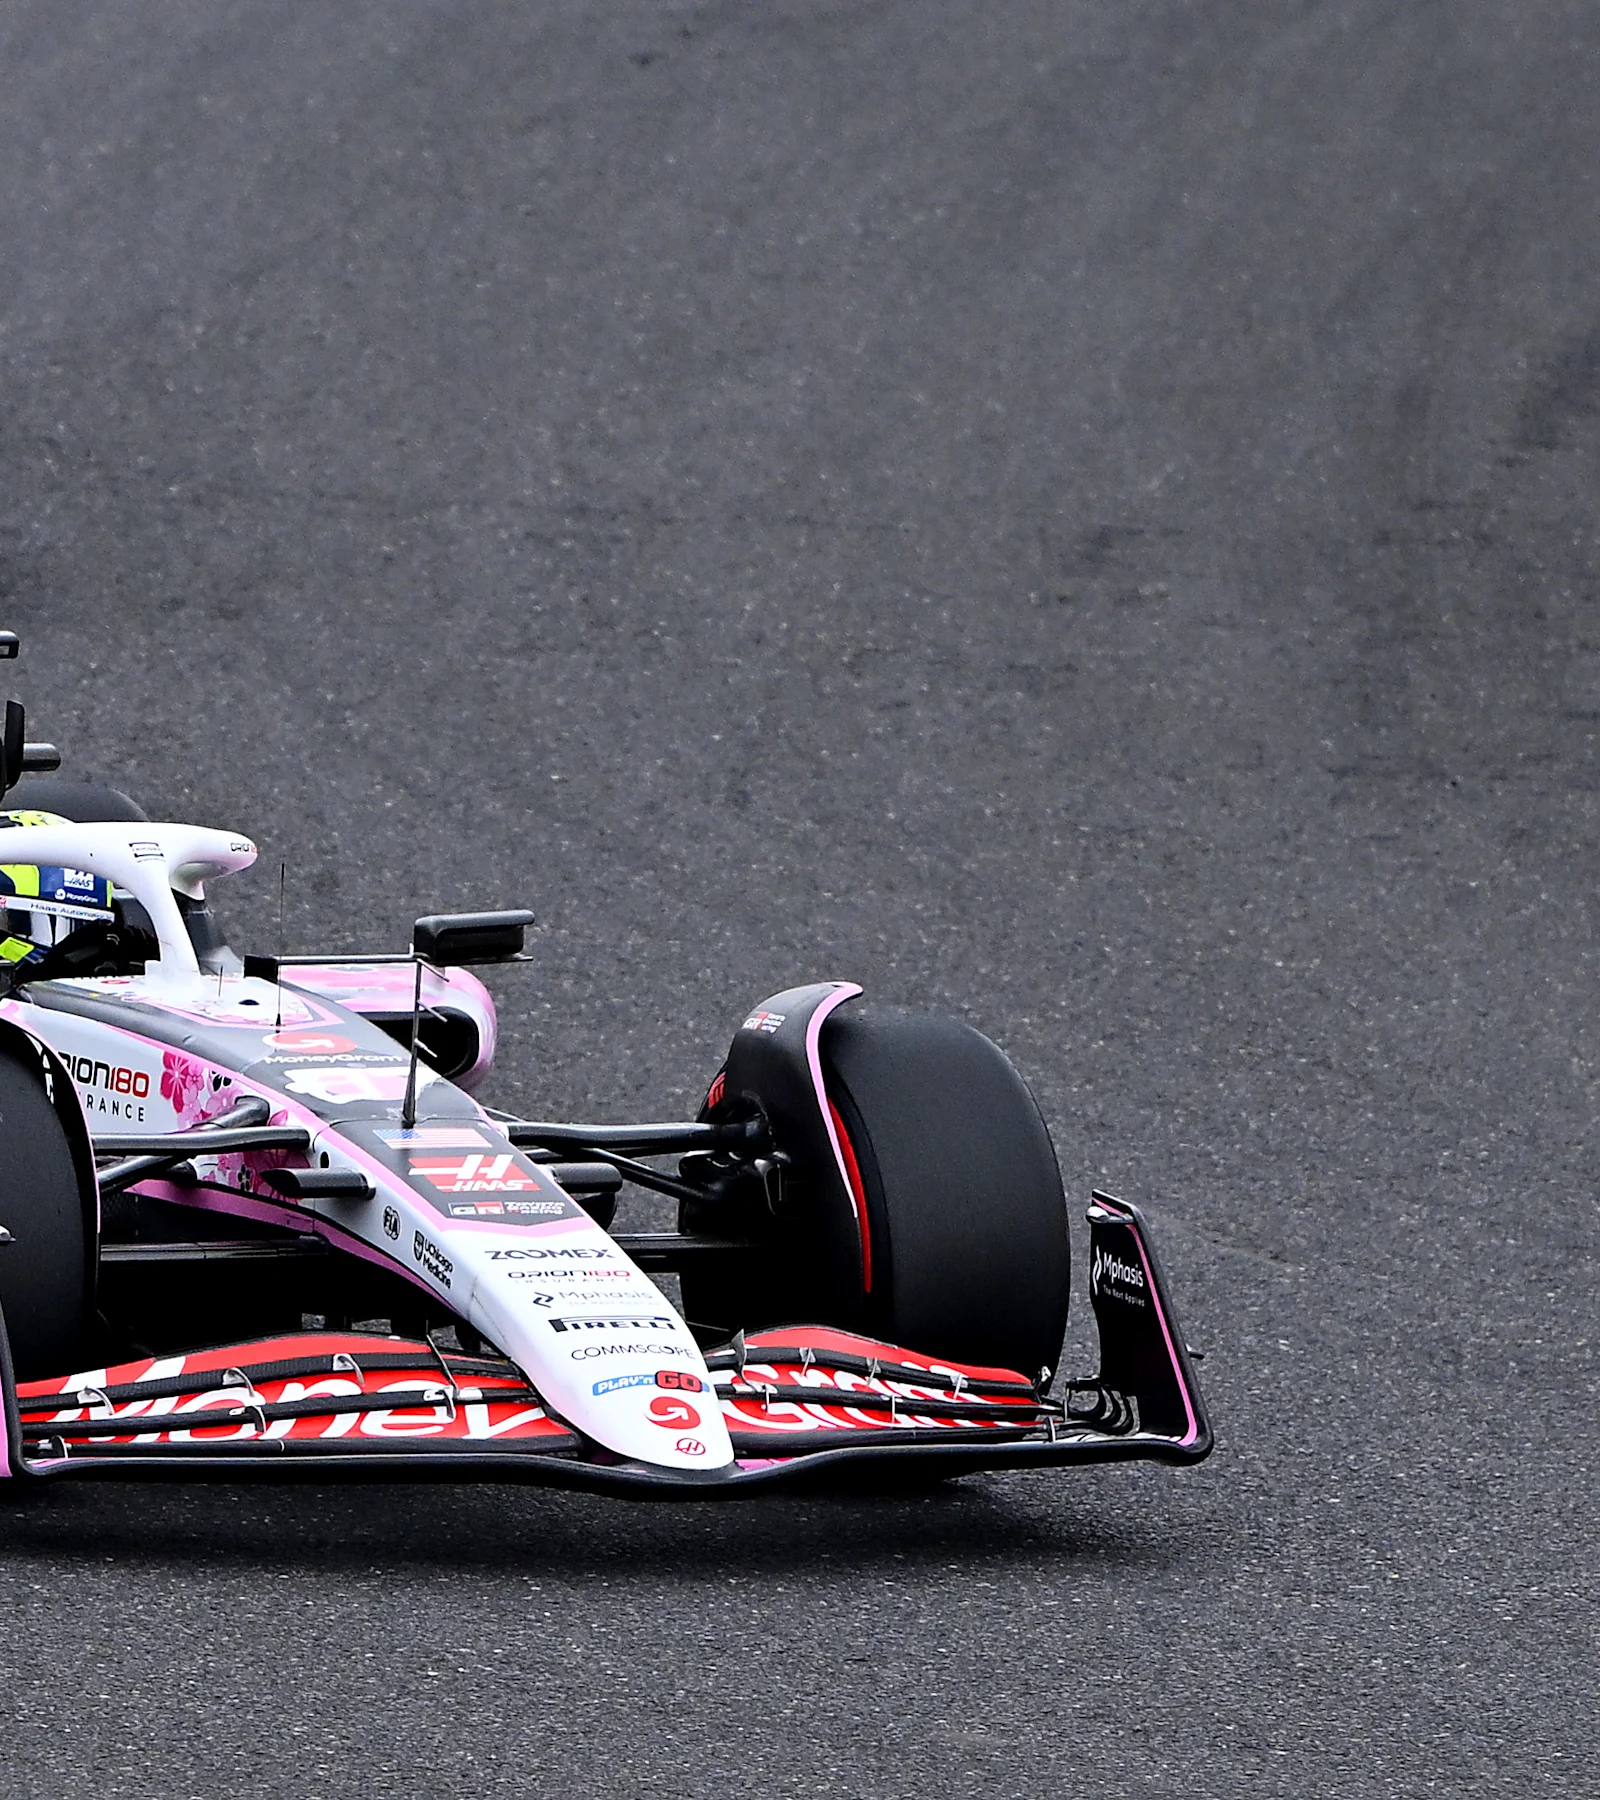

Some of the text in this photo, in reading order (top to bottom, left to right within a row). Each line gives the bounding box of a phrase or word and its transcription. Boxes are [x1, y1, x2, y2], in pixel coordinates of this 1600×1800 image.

[264, 1052, 403, 1065] MoneyGram
[1102, 1251, 1144, 1288] Mphasis
[548, 1315, 677, 1333] PIRELLI
[571, 1344, 696, 1361] COMMSCOPE
[658, 1371, 701, 1392] GO
